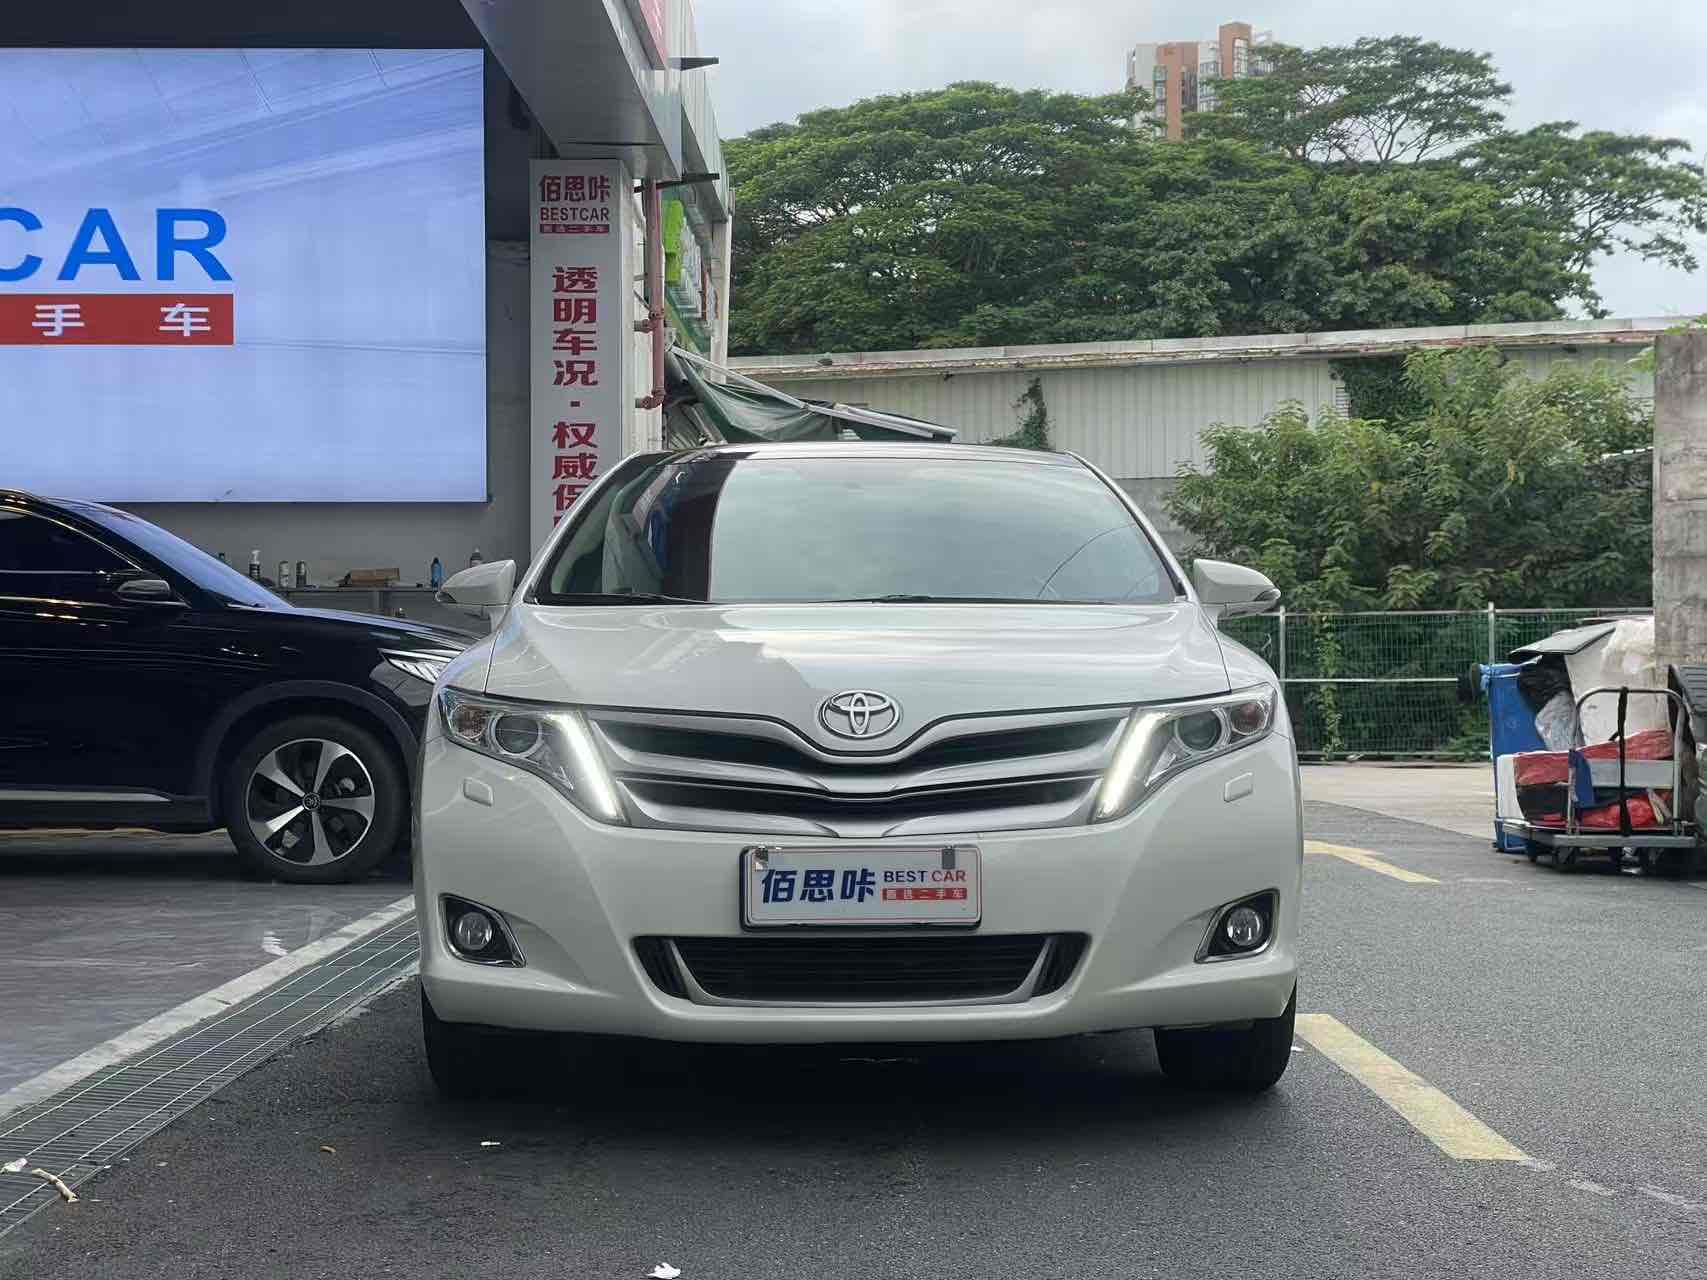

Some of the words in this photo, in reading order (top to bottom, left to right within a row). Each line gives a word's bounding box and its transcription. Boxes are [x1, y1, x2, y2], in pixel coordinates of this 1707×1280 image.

[539, 175, 610, 202] 佰思咔
[540, 207, 609, 221] BESTCAR
[552, 266, 598, 527] 透明车况·权威保
[762, 868, 876, 903] 佰思咔
[884, 870, 928, 883] BEST
[931, 870, 966, 883] CAR
